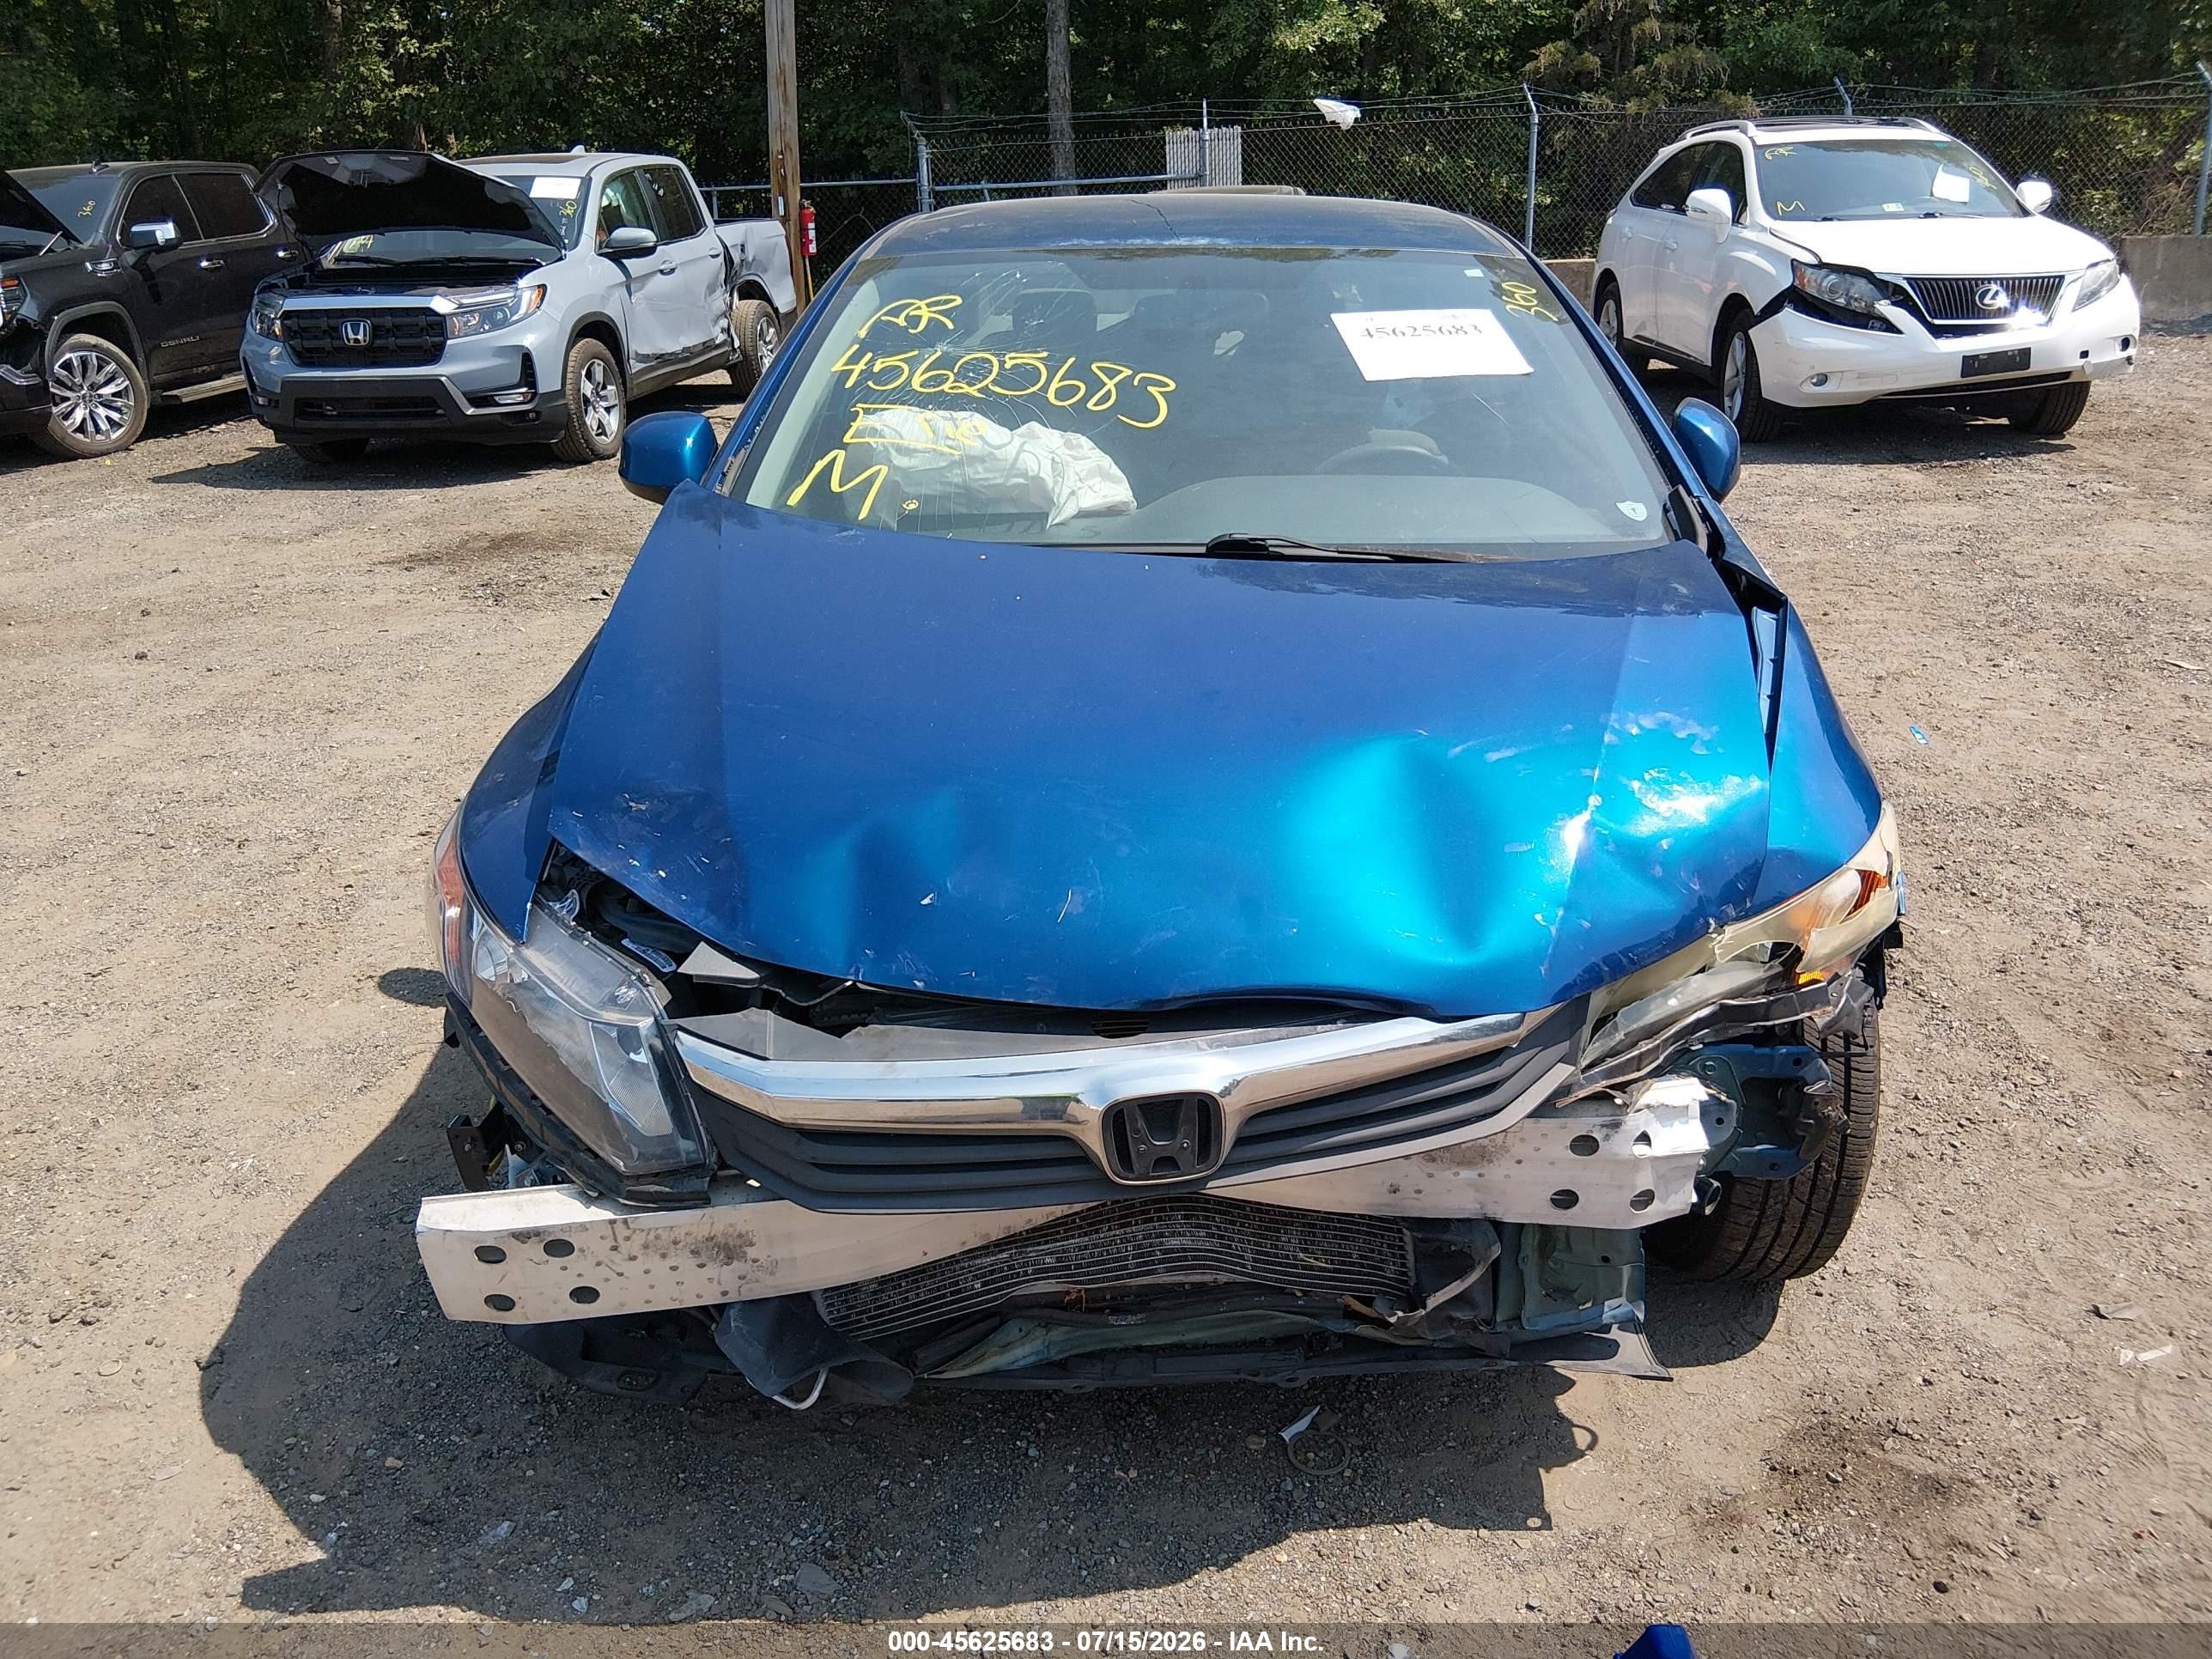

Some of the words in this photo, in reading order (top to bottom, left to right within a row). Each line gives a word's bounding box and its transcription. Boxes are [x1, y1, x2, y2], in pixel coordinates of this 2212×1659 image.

[77, 200, 96, 218] 360
[1501, 282, 1559, 321] 360
[1359, 323, 1484, 339] 45625683
[160, 335, 200, 348] DENALI
[831, 343, 1177, 429] 45625683
